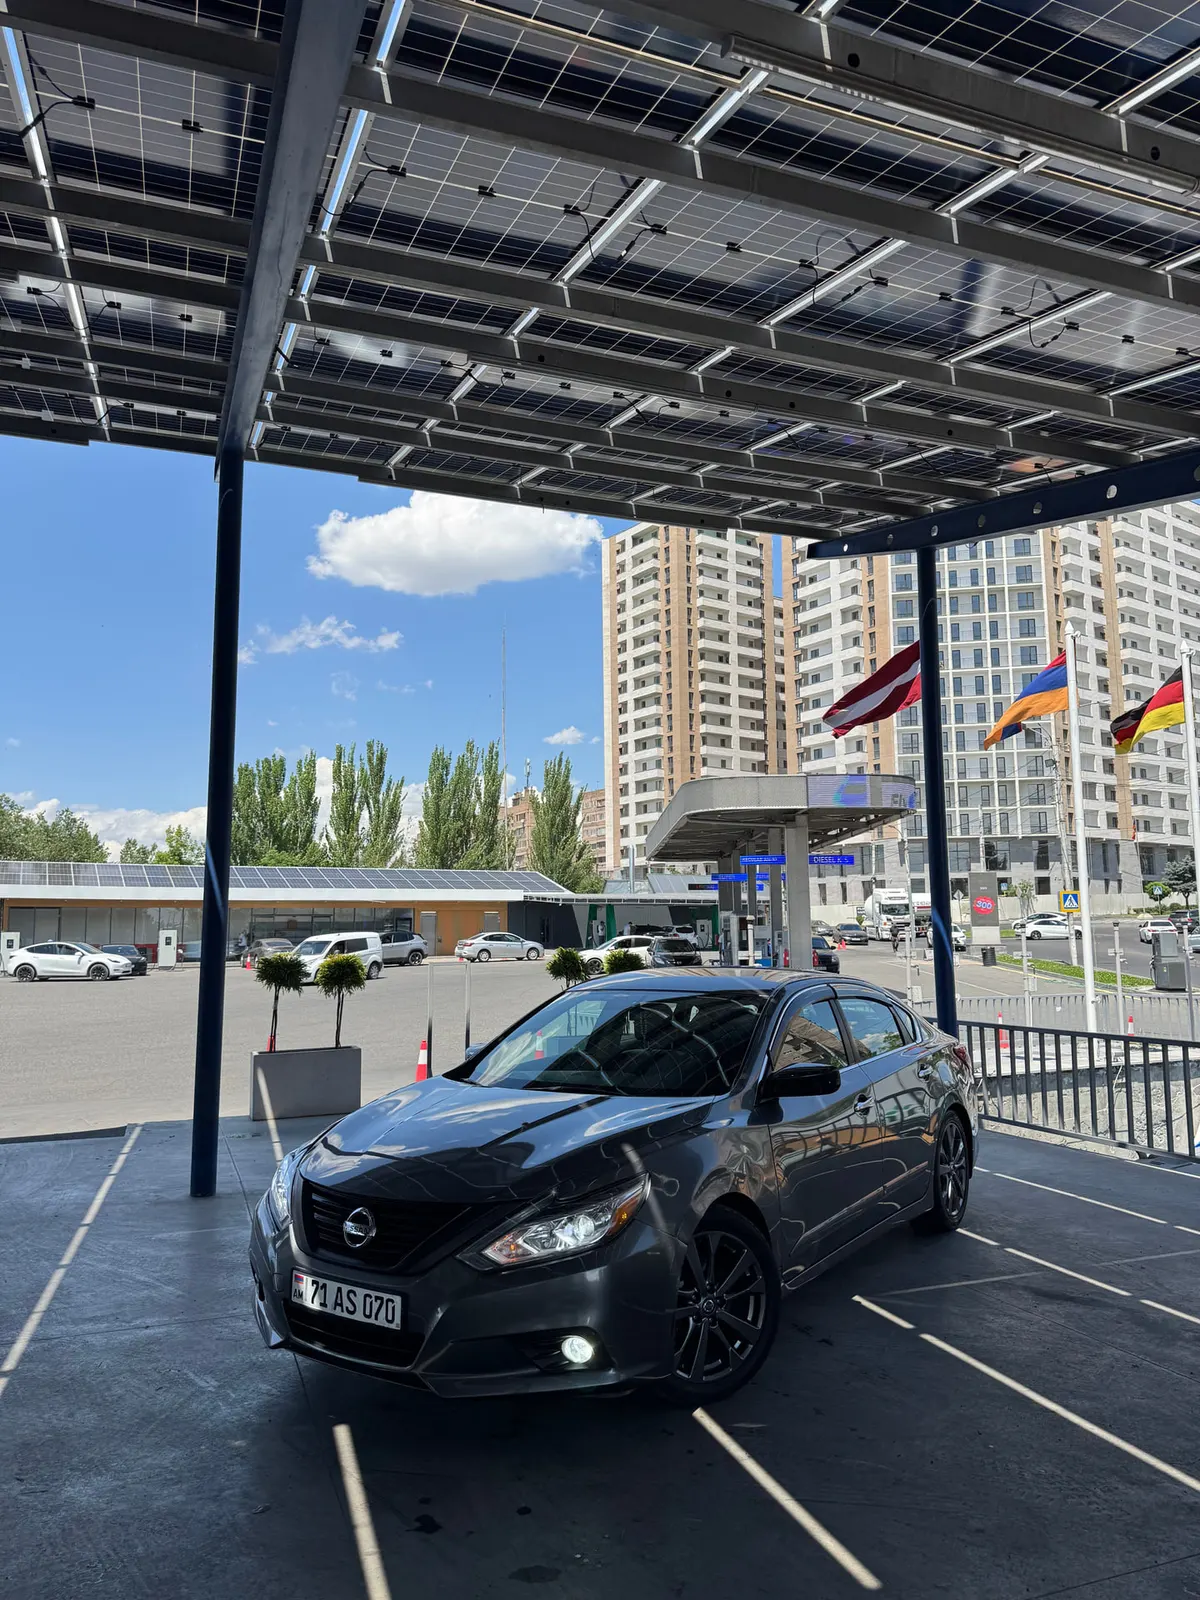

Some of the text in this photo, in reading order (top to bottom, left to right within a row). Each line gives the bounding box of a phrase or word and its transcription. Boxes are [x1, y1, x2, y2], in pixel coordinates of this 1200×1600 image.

[976, 900, 991, 908] 300
[293, 1289, 304, 1300] AM
[311, 1279, 396, 1324] 71 AS 070
